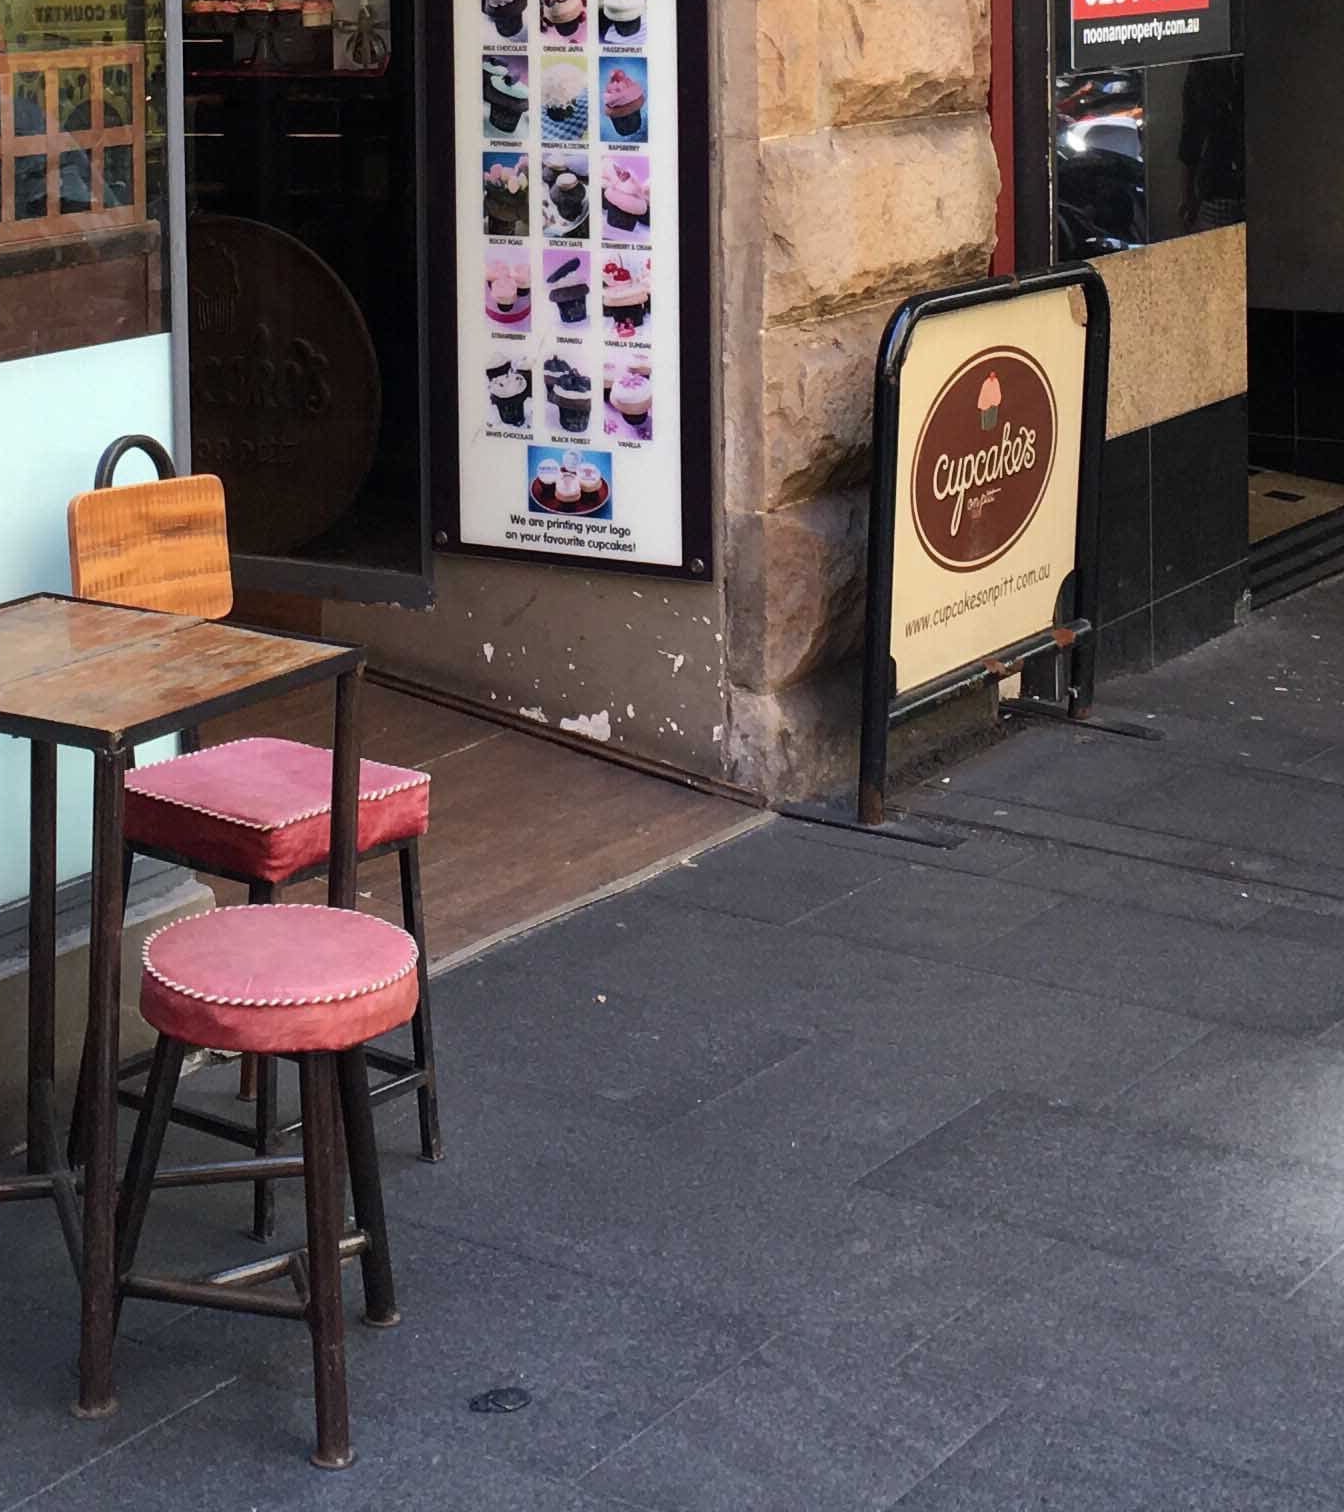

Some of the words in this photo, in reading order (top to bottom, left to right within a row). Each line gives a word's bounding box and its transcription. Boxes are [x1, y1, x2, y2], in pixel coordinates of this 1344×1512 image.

[1083, 18, 1200, 45] noonanproperty.com.au
[967, 495, 982, 513] on
[510, 514, 526, 525] We
[528, 518, 544, 527] are
[546, 518, 583, 534] printing
[585, 524, 607, 535] your
[609, 524, 631, 537] logo
[505, 531, 518, 539] on
[520, 532, 541, 543] your
[543, 533, 585, 548] favourite
[587, 539, 637, 552] cupcakes!
[904, 561, 1051, 639] www.cupcakesonpitt.com.au
